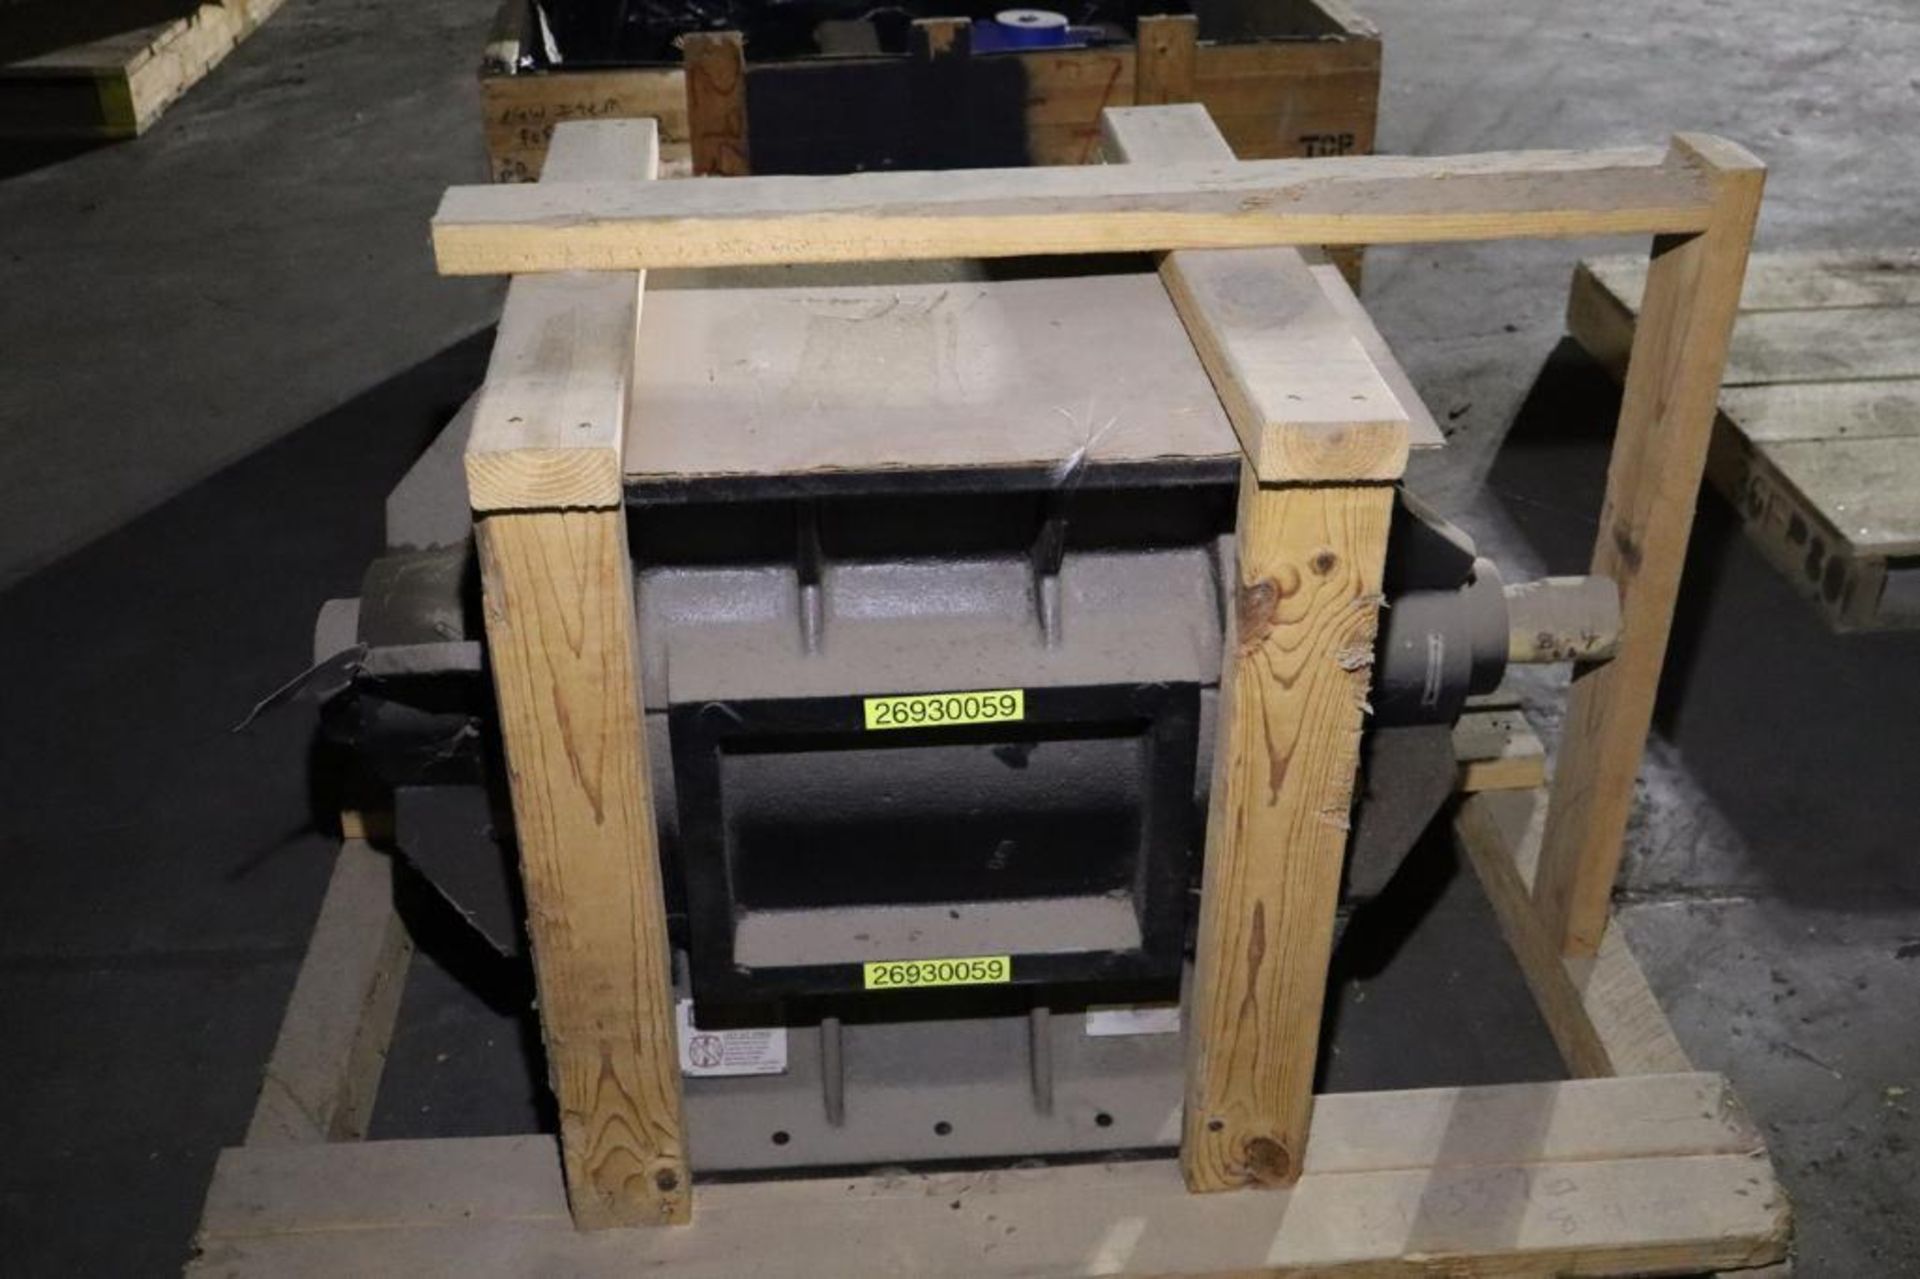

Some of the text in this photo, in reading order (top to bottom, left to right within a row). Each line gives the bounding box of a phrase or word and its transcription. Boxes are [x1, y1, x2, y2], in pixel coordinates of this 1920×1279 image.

[1298, 132, 1355, 158] TOP
[874, 694, 1017, 725] 26930059
[873, 959, 1004, 986] 26930059
